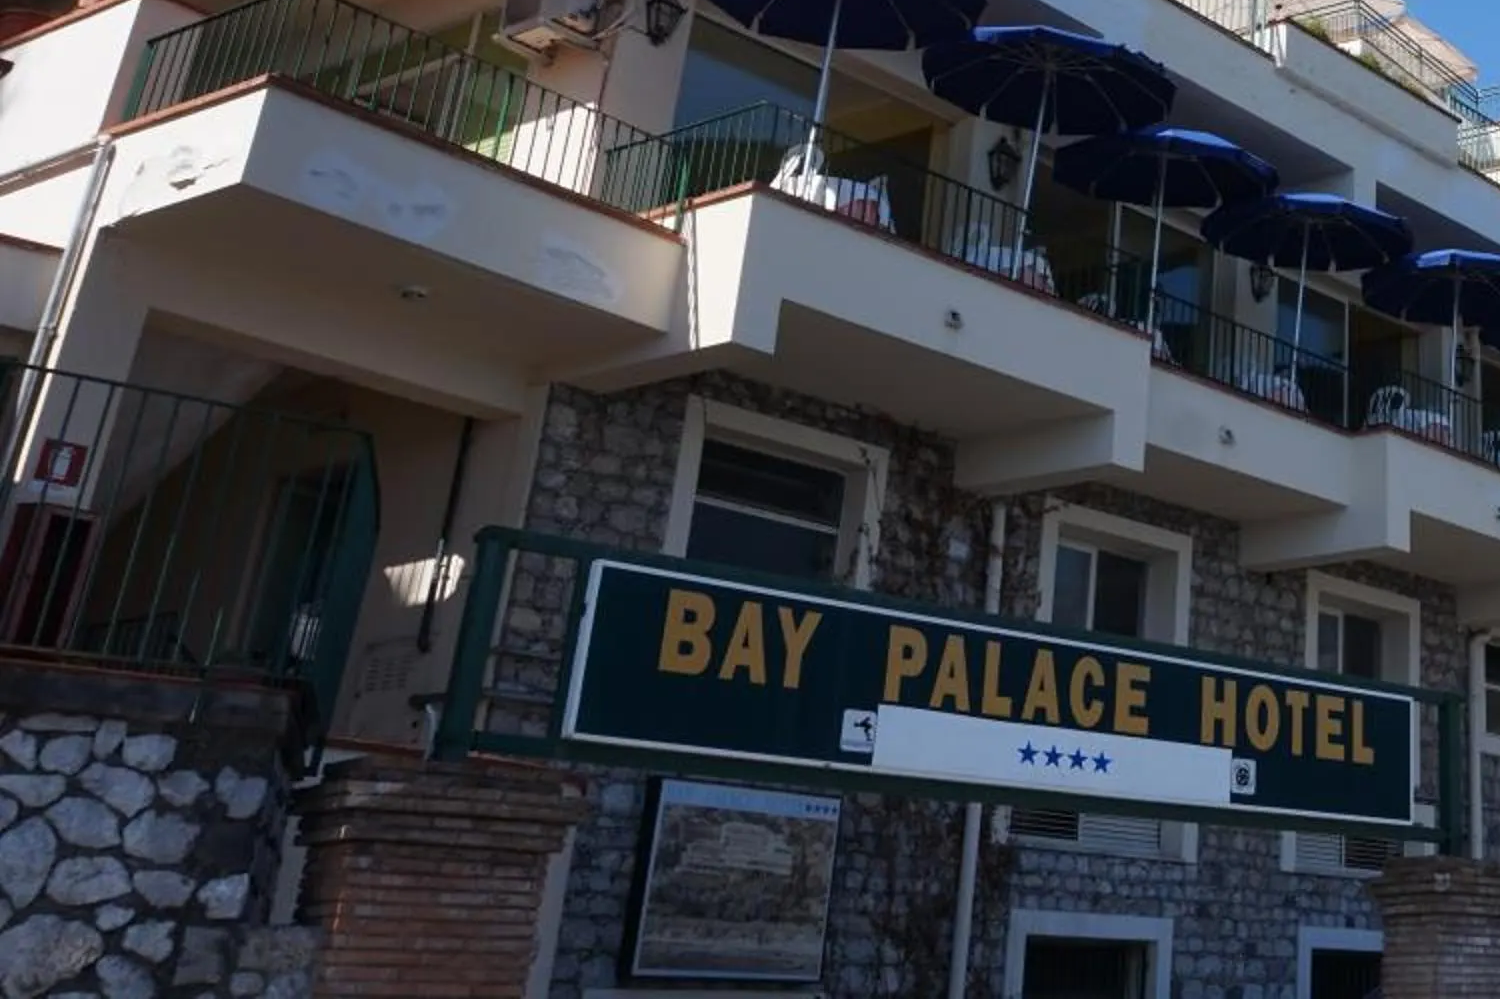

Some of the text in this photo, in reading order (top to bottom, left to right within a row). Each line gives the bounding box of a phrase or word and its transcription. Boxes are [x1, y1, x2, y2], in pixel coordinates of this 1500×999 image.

[658, 589, 1375, 764] BAY PALACE HOTEL
